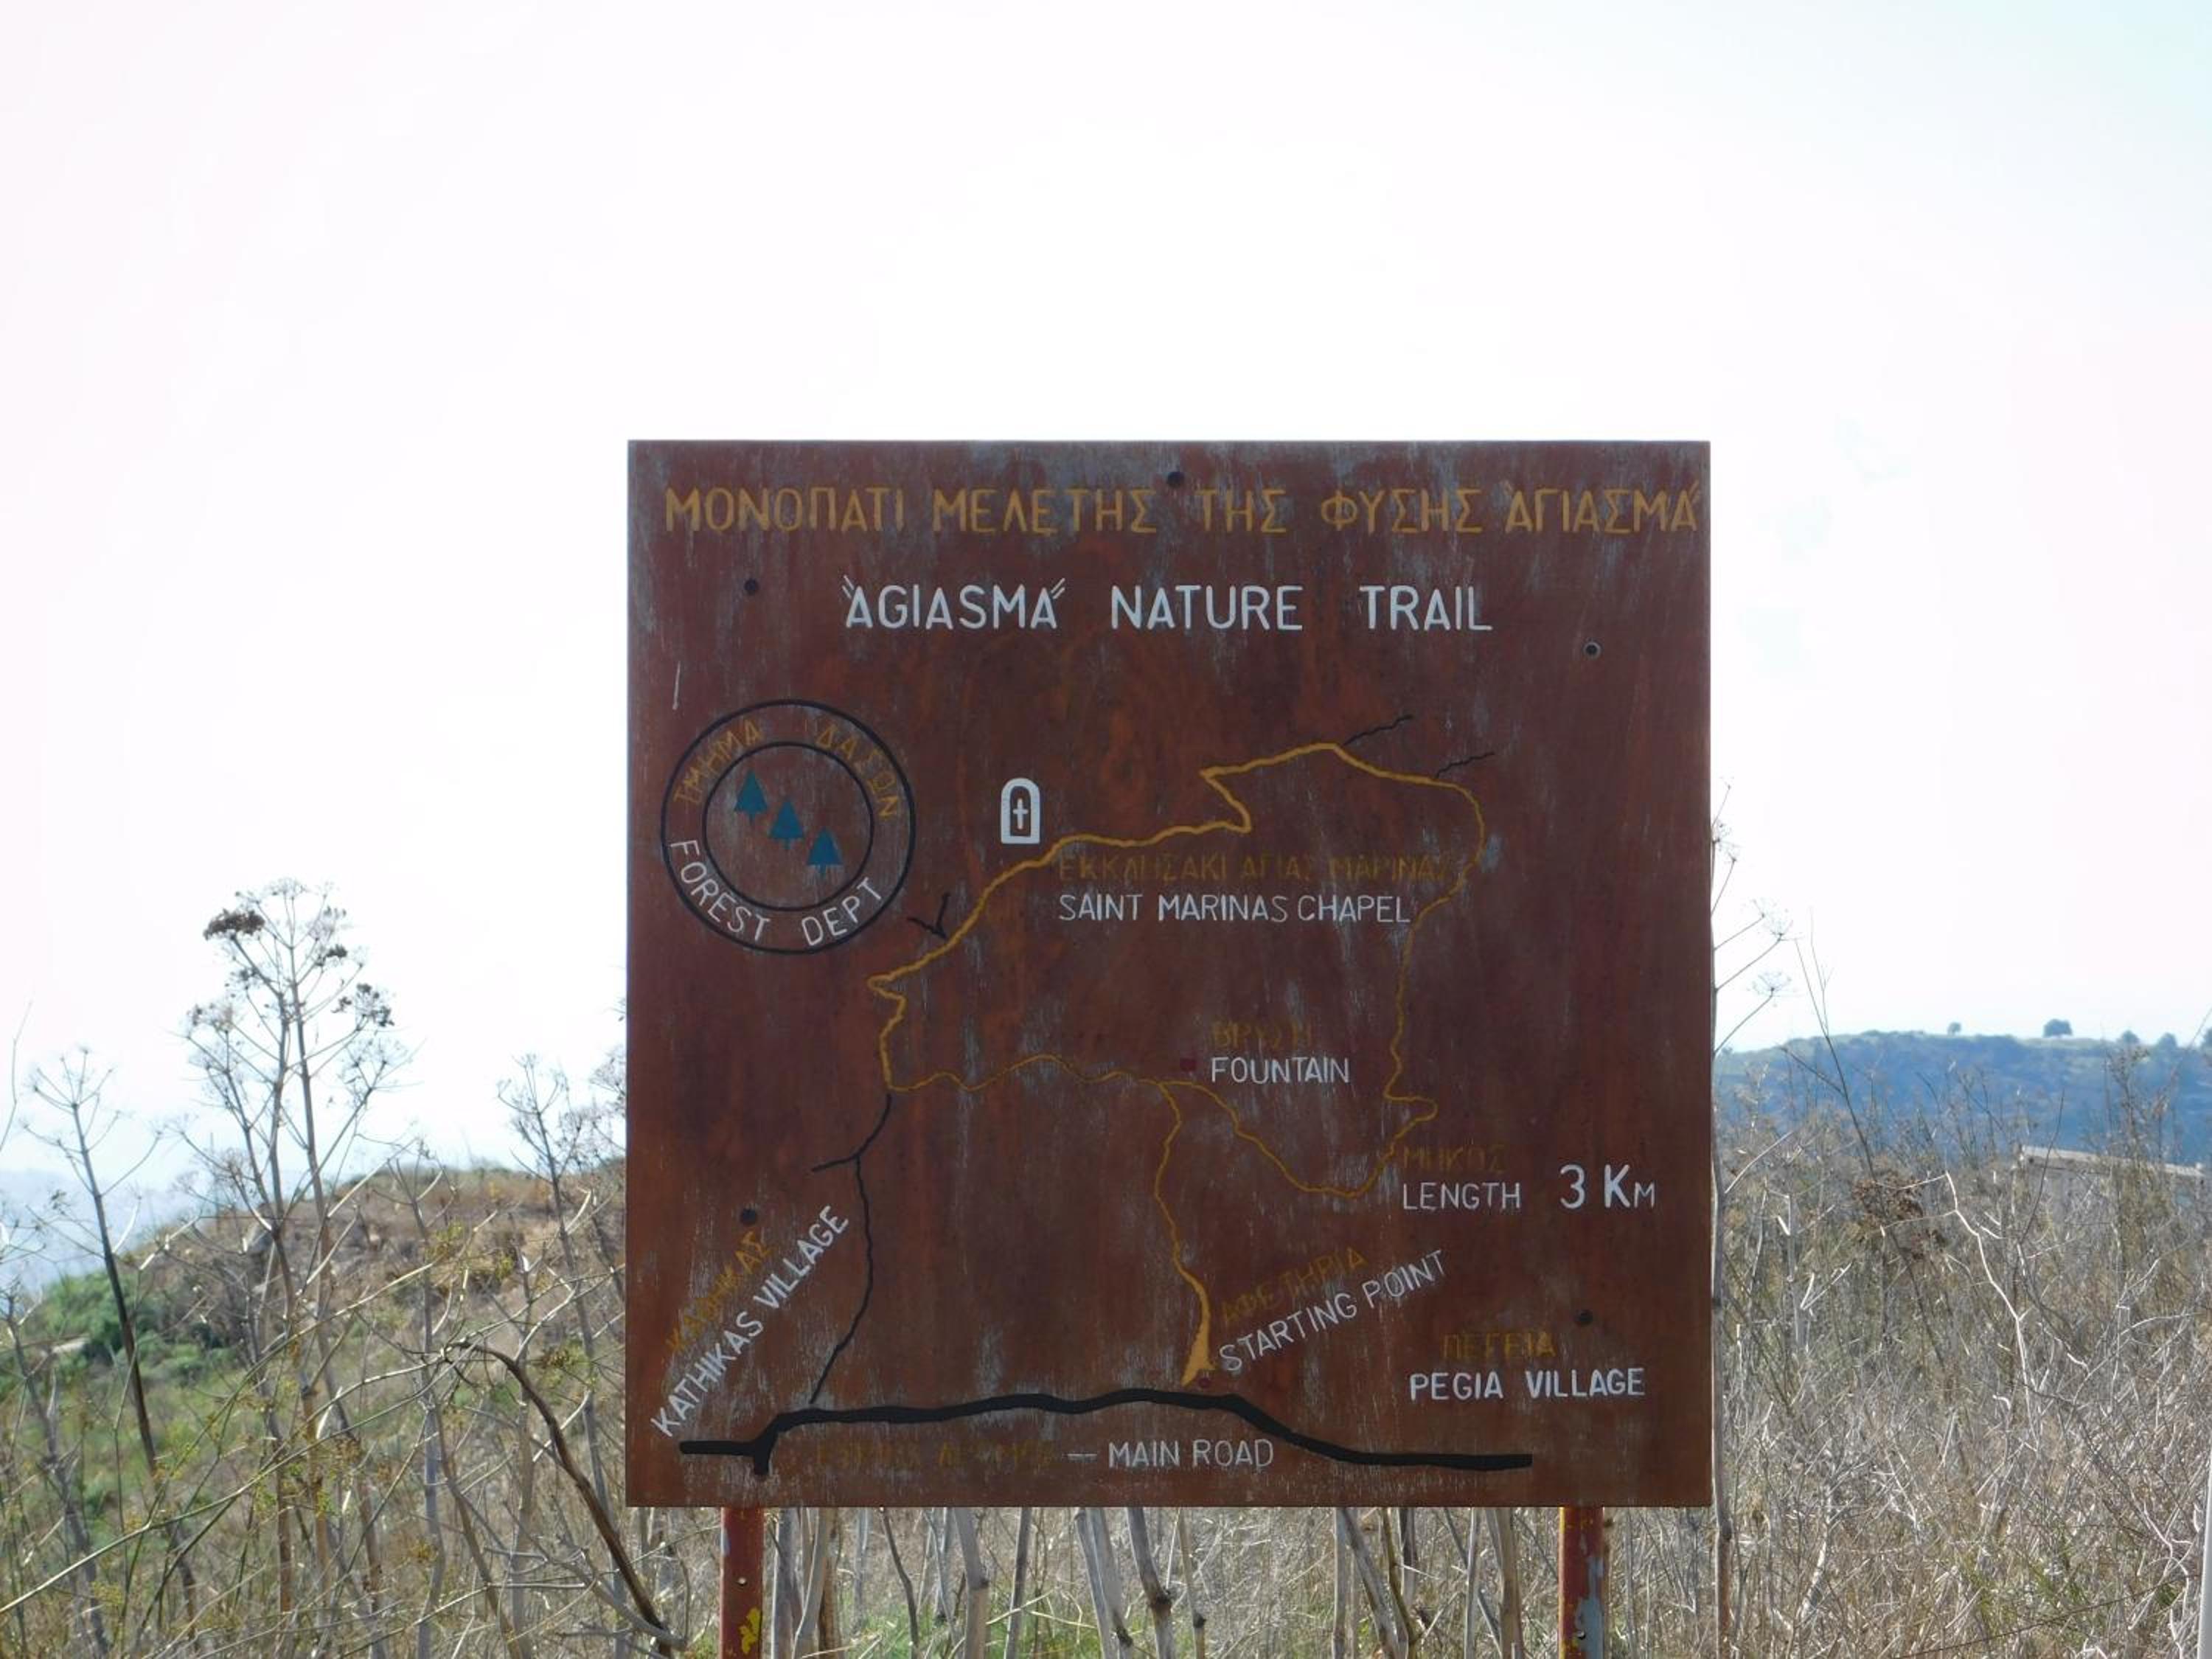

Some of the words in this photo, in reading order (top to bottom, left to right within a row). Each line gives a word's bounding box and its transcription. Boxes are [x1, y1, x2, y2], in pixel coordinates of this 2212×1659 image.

[664, 486, 905, 533] ΜΟΝΟΠΑΤΙ
[932, 487, 1158, 535] ΜΕΛΕΤΗΣ
[1195, 487, 1287, 534] ΤΗΣ
[1320, 487, 1483, 534] ΦΥΣΗΣ
[1111, 584, 1304, 630] NATURE
[1359, 584, 1493, 630] TRAIL
[669, 839, 771, 942] FOREST
[801, 876, 883, 947] DEPT
[1058, 894, 1143, 922] SAINT
[1158, 894, 1288, 922] MARINAS
[1297, 894, 1411, 923] CHAPEL
[1211, 1057, 1351, 1085] FOUNTAIN
[1402, 1182, 1522, 1211] LENGTH
[1559, 1164, 1587, 1209] 3
[650, 1311, 764, 1437] KATHIKAS
[752, 1205, 849, 1309] VILLAGE
[1218, 1292, 1358, 1372] STARTING
[1361, 1249, 1447, 1310] POINT
[1409, 1372, 1503, 1401] PEGIA
[1525, 1368, 1646, 1399] VILLAGE
[1107, 1439, 1181, 1469] MAIN
[1192, 1439, 1275, 1468] ROAD
